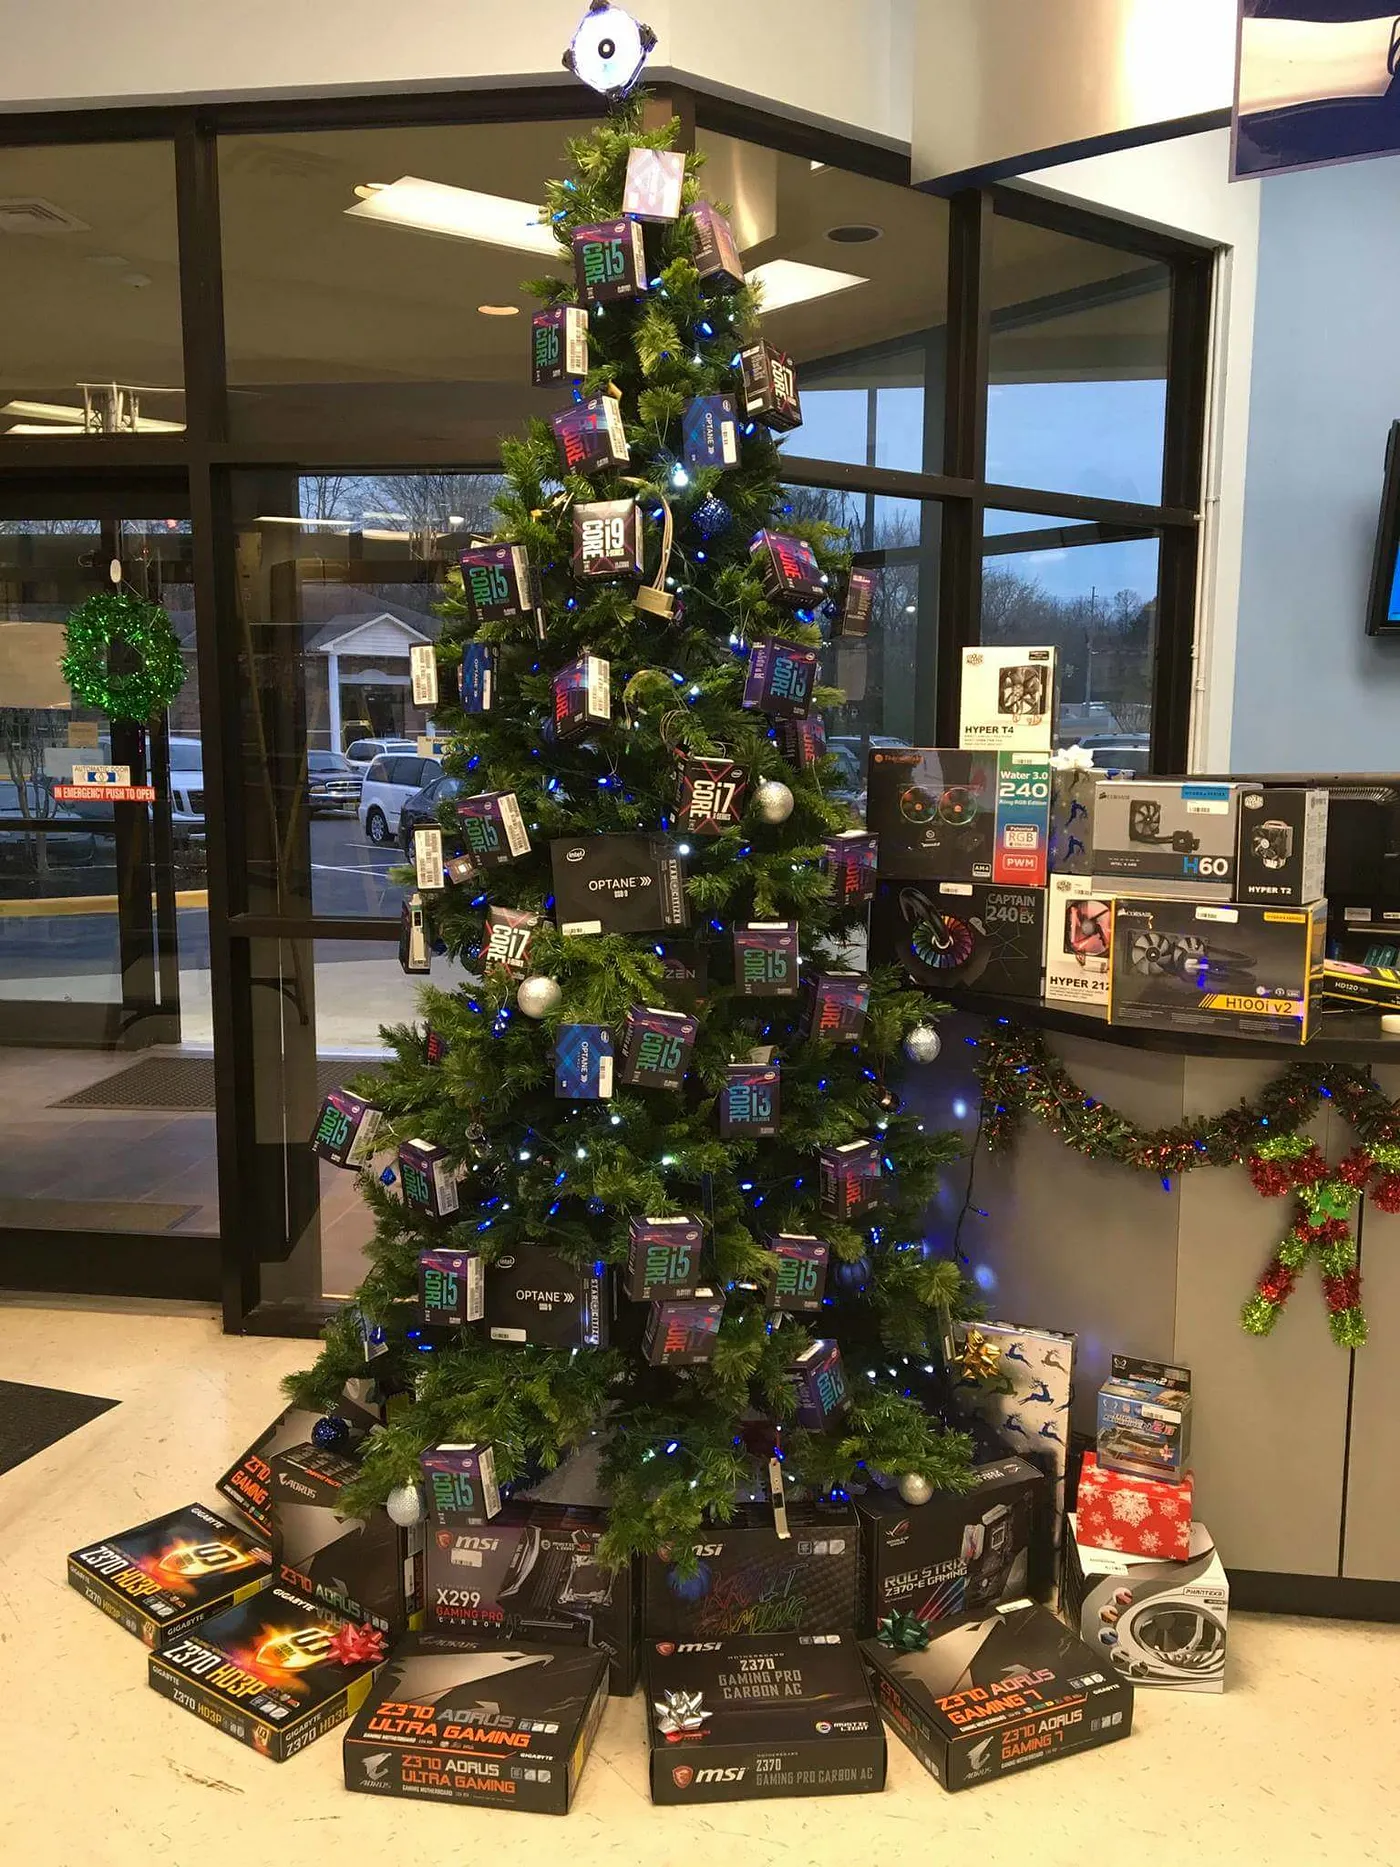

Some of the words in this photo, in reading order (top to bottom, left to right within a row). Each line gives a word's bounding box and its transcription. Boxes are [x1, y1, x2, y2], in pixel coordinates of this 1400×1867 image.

[583, 242, 606, 286] CORE
[604, 238, 625, 275] i5
[536, 327, 548, 368] CORE
[548, 323, 559, 360] i5
[771, 360, 787, 400] CORE
[705, 412, 715, 446] OPTANE
[582, 520, 604, 560] CORE
[604, 518, 625, 550] i9
[469, 566, 493, 607] CORE
[488, 564, 509, 598] i5
[770, 656, 793, 698] CORE
[964, 726, 998, 734] HYPER
[1002, 726, 1014, 734] T4
[1000, 771, 1030, 780] Water
[1032, 772, 1048, 780] 3.0
[1000, 782, 1048, 798] 240
[54, 786, 62, 798] IN
[63, 787, 104, 799] EMERGENCY
[106, 788, 125, 800] PUSH
[126, 788, 135, 800] TO
[136, 788, 155, 800] OPEN
[690, 780, 716, 818] CORE
[714, 782, 736, 813] i7
[464, 818, 488, 854] CORE
[480, 815, 498, 846] i5
[1008, 832, 1034, 842] RGB
[567, 848, 584, 860] intel
[1006, 858, 1034, 868] PWM
[1183, 856, 1228, 876] H60
[588, 877, 636, 891] OPTANE
[668, 859, 678, 883] STAR
[988, 892, 1036, 906] CAPTAIN
[1248, 886, 1278, 894] HYPER
[672, 891, 680, 924] CITIZEN
[986, 906, 1018, 922] 240
[1020, 914, 1034, 924] EX
[487, 924, 512, 964] CORE
[508, 928, 531, 960] i7
[665, 970, 696, 978] ZEN
[744, 949, 766, 983] CORE
[768, 950, 787, 978] i5
[1050, 976, 1088, 988] HYPER
[1334, 981, 1358, 992] HD120
[1226, 998, 1268, 1012] H100i
[1274, 1002, 1292, 1014] v2
[636, 1032, 664, 1072] CORE
[660, 1035, 684, 1069] i5
[729, 1086, 750, 1122] CORE
[316, 1106, 340, 1144] CORE
[332, 1112, 353, 1144] i5
[644, 1246, 670, 1287] CORE
[670, 1245, 692, 1278] i5
[776, 1258, 799, 1296] CORE
[798, 1260, 819, 1290] i5
[425, 1270, 442, 1310] CORE
[442, 1272, 458, 1305] i5
[516, 1290, 560, 1302] OPTANE
[816, 1372, 836, 1416] CORE
[231, 1470, 269, 1506] GAMING
[285, 1479, 318, 1500] AORUS
[432, 1472, 457, 1512] CORE
[453, 1472, 474, 1508] i5
[190, 1507, 226, 1529] GIGABYTE
[456, 1534, 500, 1552] msi
[80, 1545, 129, 1576] Z370
[110, 1567, 163, 1598] HD3P
[884, 1570, 918, 1588] ROG
[921, 1558, 967, 1579] STRIX
[884, 1580, 926, 1598] Z370-E
[927, 1566, 968, 1586] GAMING
[84, 1587, 102, 1604] Z370
[102, 1599, 122, 1620] HD3P
[272, 1588, 316, 1612] GIGABYTE
[315, 1584, 360, 1618] AORUS
[436, 1588, 481, 1608] X299
[1186, 1588, 1223, 1596] PHANTEKS
[168, 1614, 204, 1636] GIGABYTE
[436, 1606, 478, 1620] GAMING
[480, 1610, 504, 1622] PRO
[678, 1641, 722, 1654] msi
[728, 1652, 785, 1660] MOTHERBOARD
[152, 1666, 180, 1686] GIGABYTE
[162, 1640, 222, 1675] Z370
[205, 1663, 269, 1698] HD3P
[718, 1670, 771, 1686] GAMING
[775, 1670, 802, 1682] PRO
[723, 1685, 780, 1700] CARBON
[784, 1683, 802, 1696] AC
[934, 1687, 990, 1712] Z370
[990, 1668, 1056, 1696] AORUS
[173, 1688, 196, 1710] Z370
[197, 1703, 222, 1724] HD3P
[376, 1702, 436, 1720] Z370
[437, 1708, 516, 1729] AORUS
[947, 1694, 1027, 1726] GAMING
[1023, 1689, 1044, 1700] 7
[285, 1712, 322, 1741] GIGABYTE
[286, 1727, 317, 1757] Z370
[318, 1704, 349, 1734] HD3P
[368, 1717, 438, 1737] ULTRA
[442, 1726, 532, 1748] GAMING
[1002, 1724, 1036, 1744] Z370
[1038, 1709, 1084, 1734] AORUS
[520, 1752, 554, 1761] GIGABYTE
[1001, 1734, 1052, 1760] GAMING
[1056, 1730, 1064, 1742] 7
[401, 1754, 440, 1770] Z370
[444, 1758, 500, 1777] AORUS
[696, 1766, 747, 1784] msi
[756, 1772, 795, 1786] GAMING
[796, 1770, 816, 1784] PRO
[818, 1768, 856, 1783] CARBON
[860, 1767, 874, 1780] AC
[402, 1770, 450, 1787] ULTRA
[454, 1776, 516, 1794] GAMING
[420, 1786, 453, 1796] MOTHERBOARD
